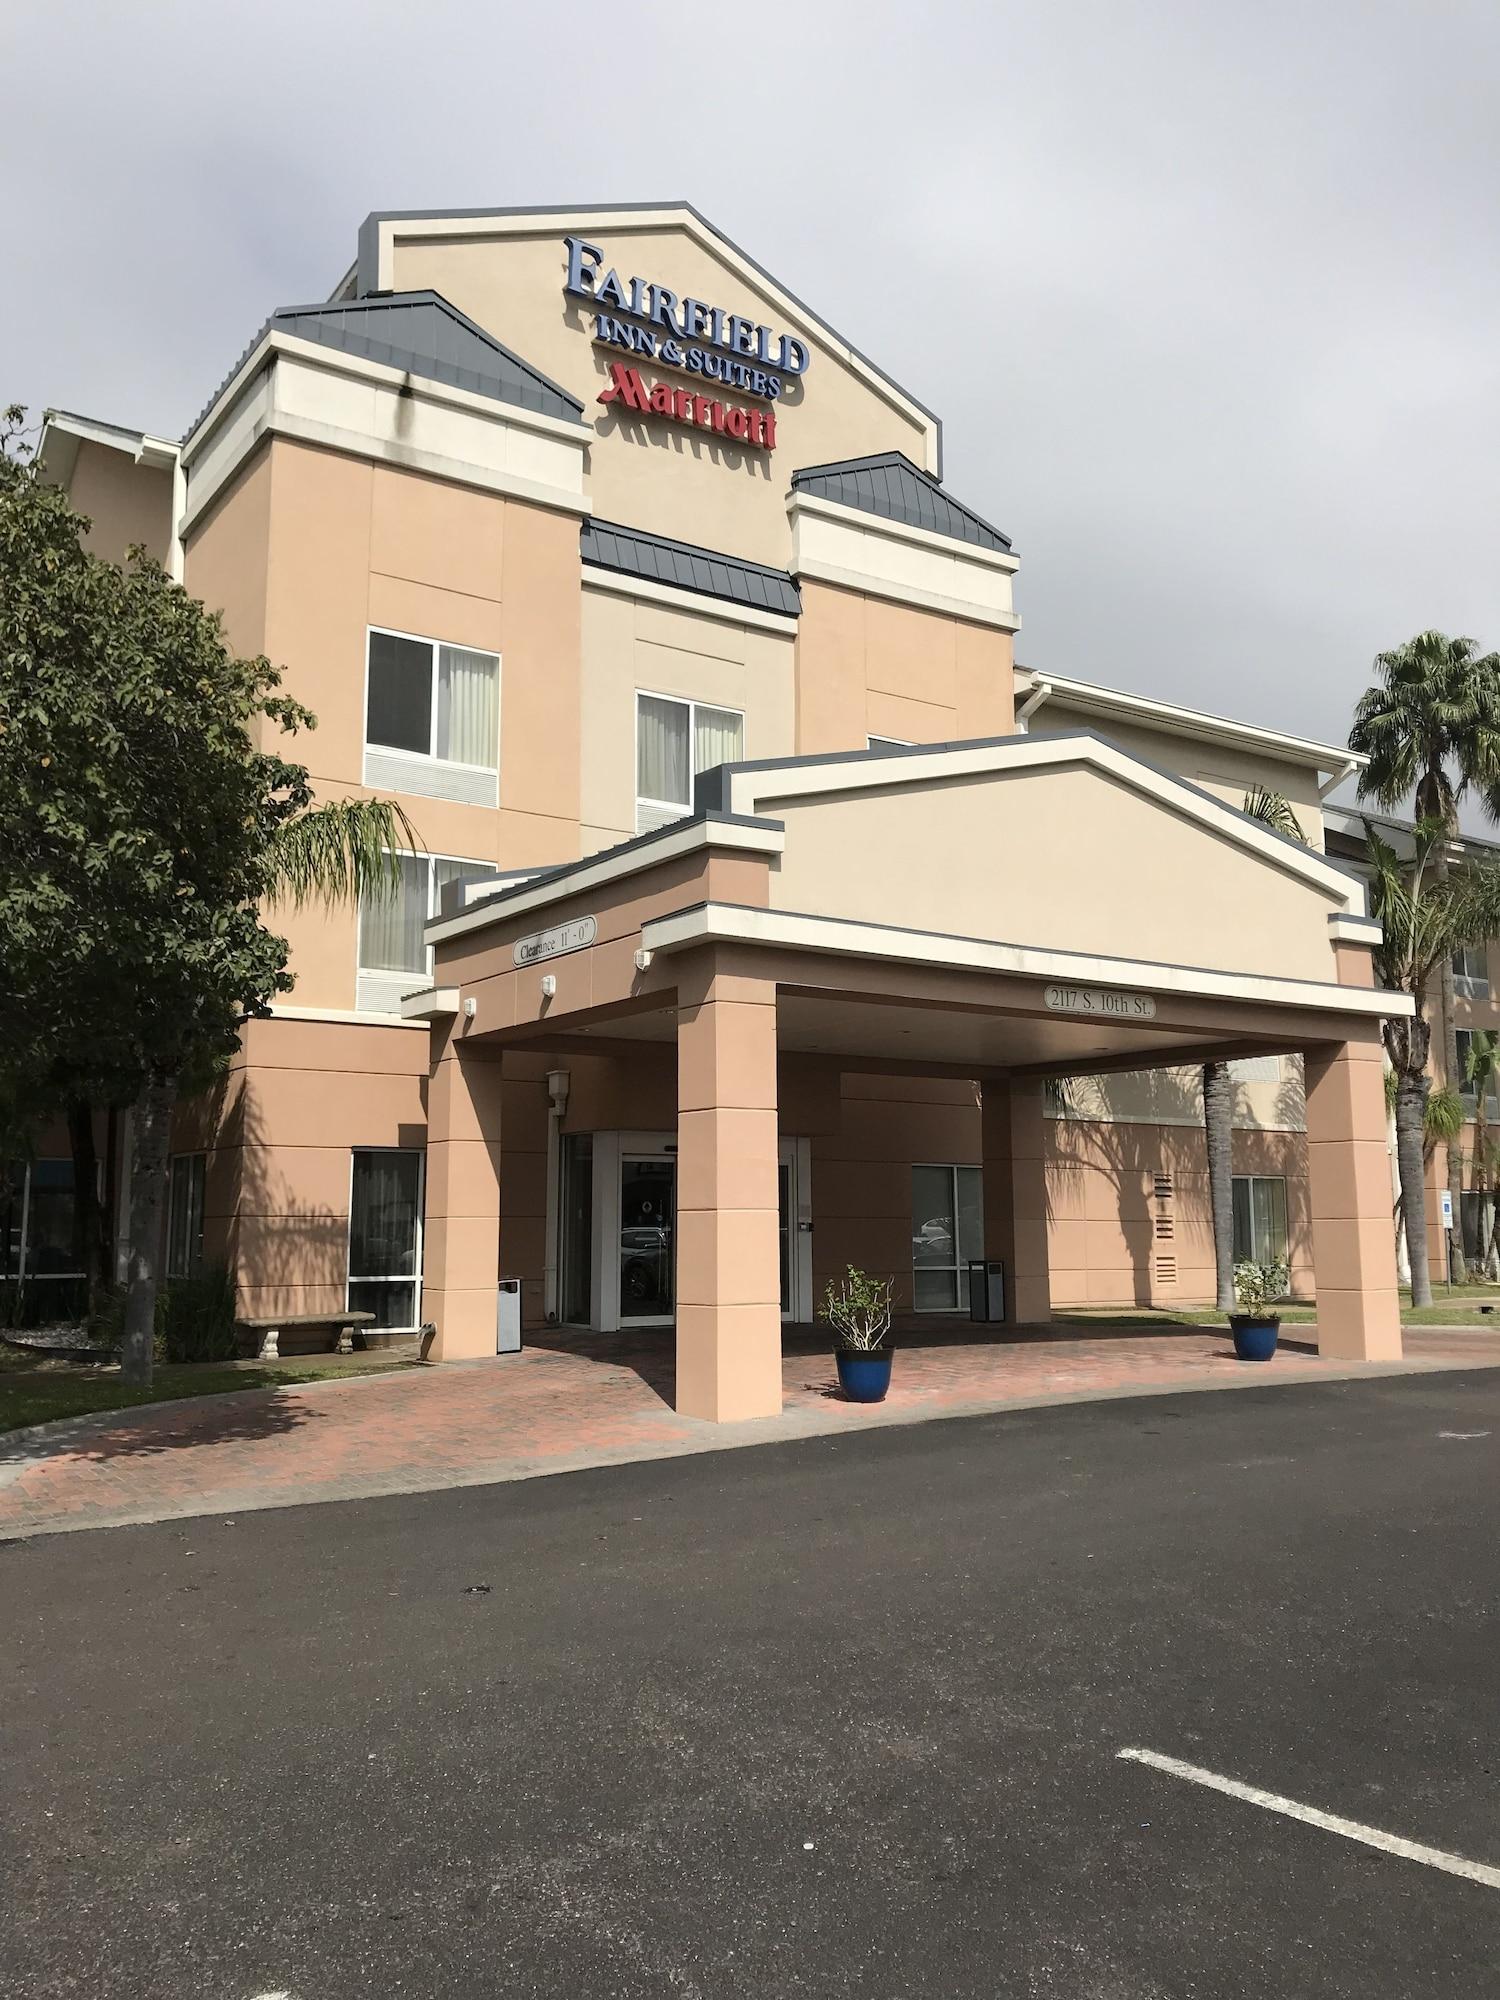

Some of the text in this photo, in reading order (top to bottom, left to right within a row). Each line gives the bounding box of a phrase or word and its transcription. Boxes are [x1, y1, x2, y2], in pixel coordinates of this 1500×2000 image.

[564, 236, 810, 376] FAIRFIELD
[595, 314, 782, 400] INN & SUITES
[597, 361, 777, 450] Marriott
[520, 940, 556, 960] Clearance
[1051, 989, 1151, 1015] 2117 S. 10th St.
